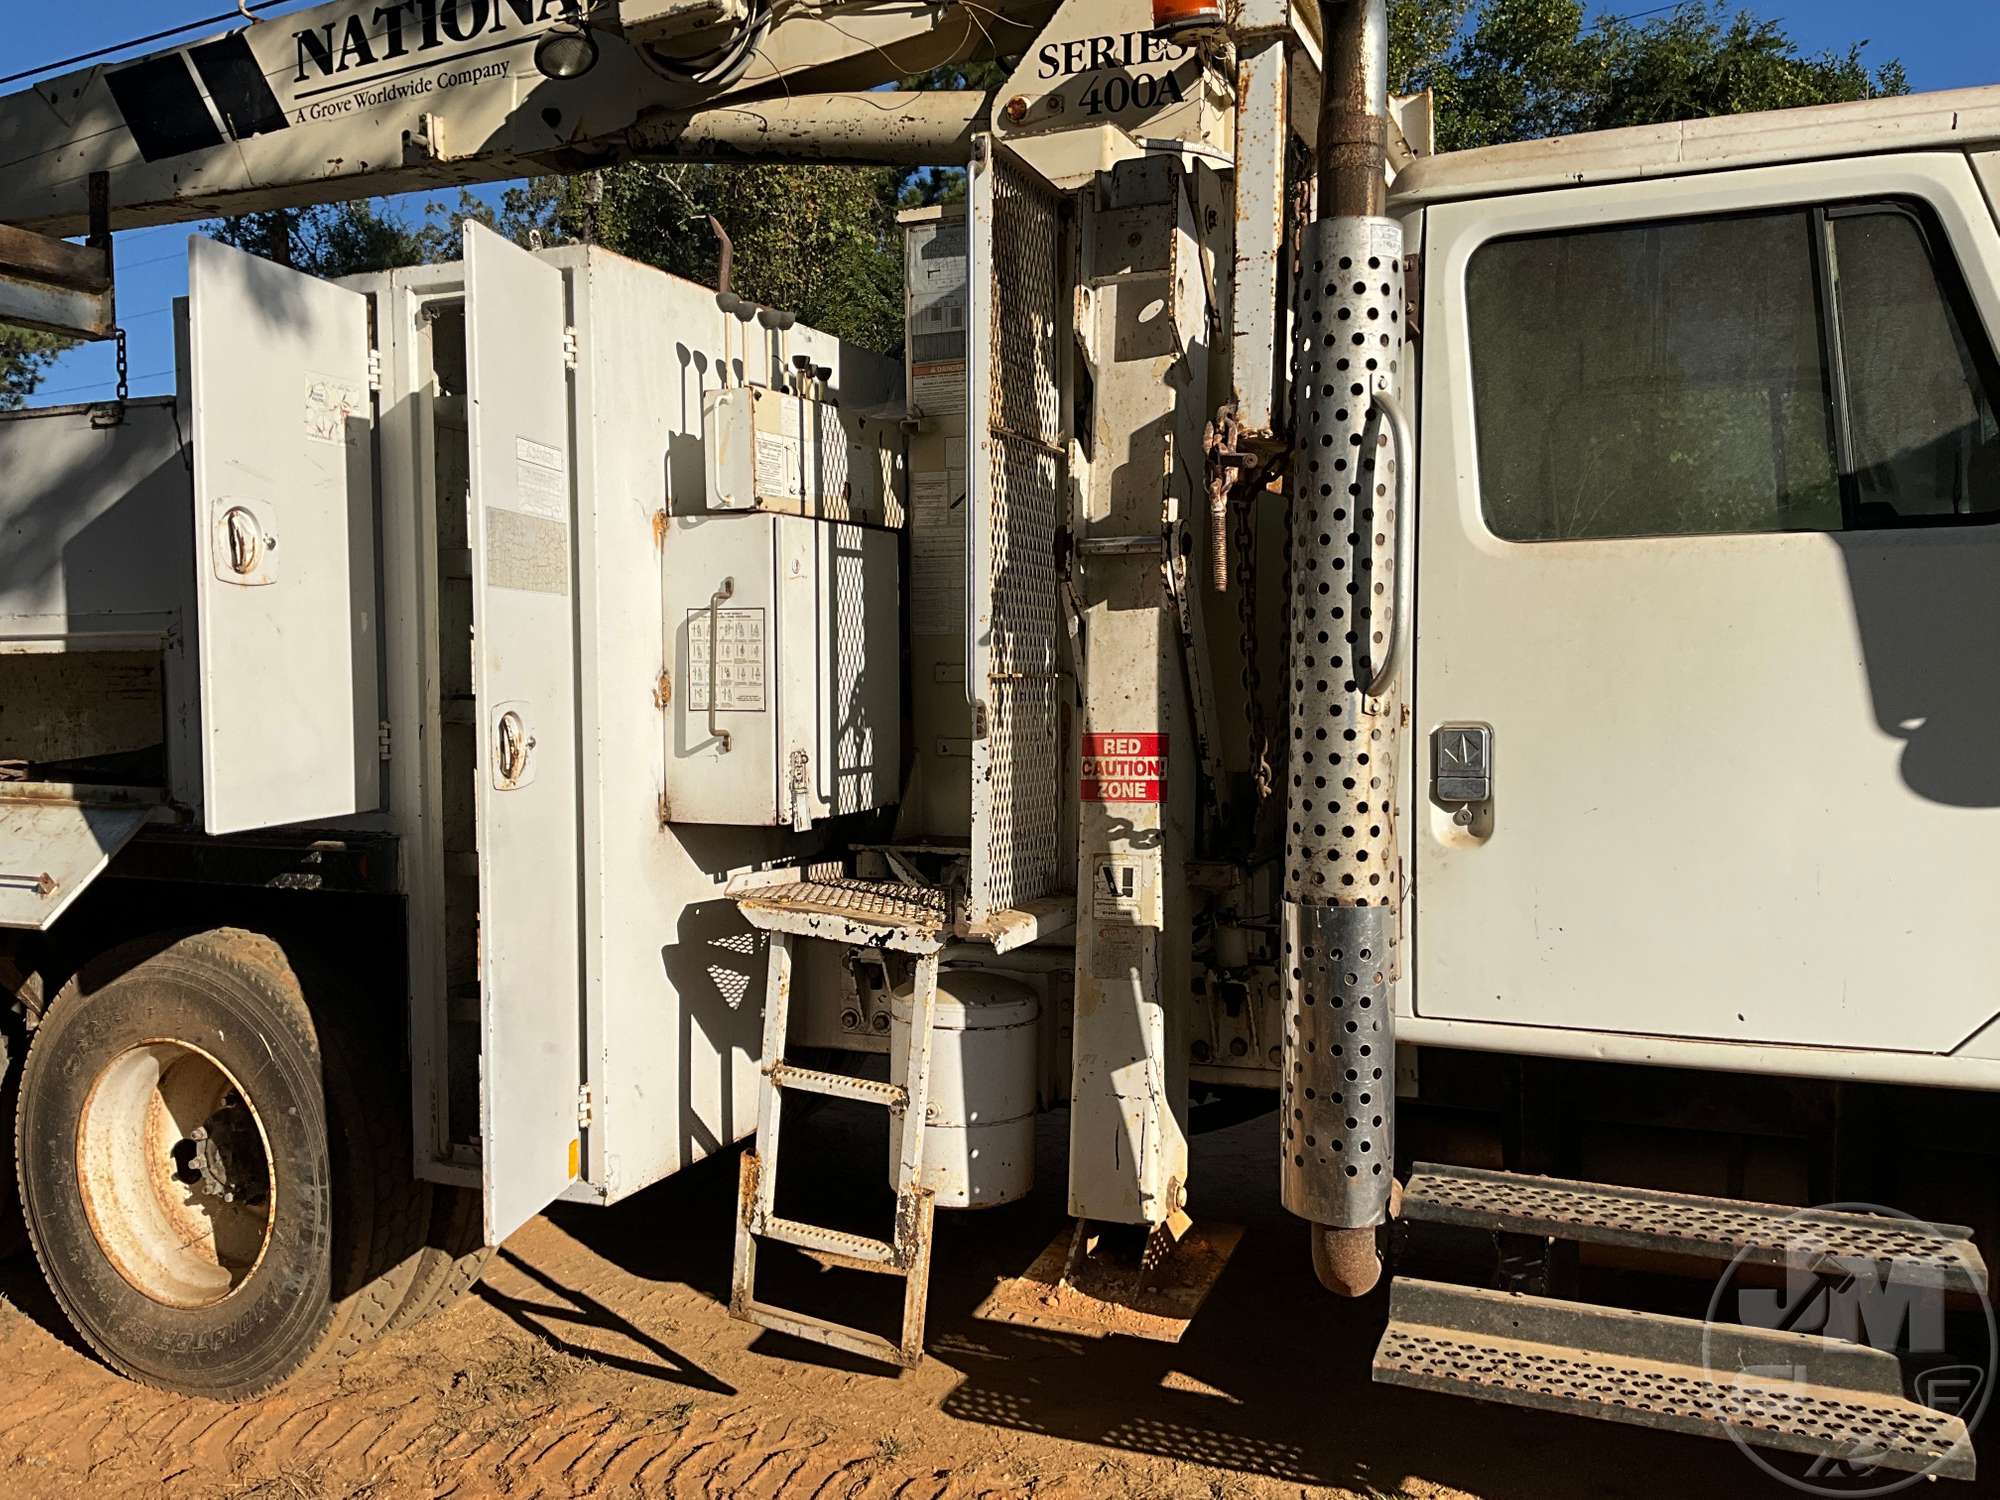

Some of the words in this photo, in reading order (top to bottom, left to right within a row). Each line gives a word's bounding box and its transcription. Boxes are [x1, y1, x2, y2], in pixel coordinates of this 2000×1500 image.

[295, 107, 306, 124] A
[310, 99, 351, 119] Grove
[353, 77, 433, 109] Worldwide
[437, 60, 510, 89] Company
[1079, 69, 1187, 116] 400A
[1103, 738, 1142, 754] RED
[1082, 760, 1165, 776] CAUTION!
[1098, 782, 1147, 798] ZONE
